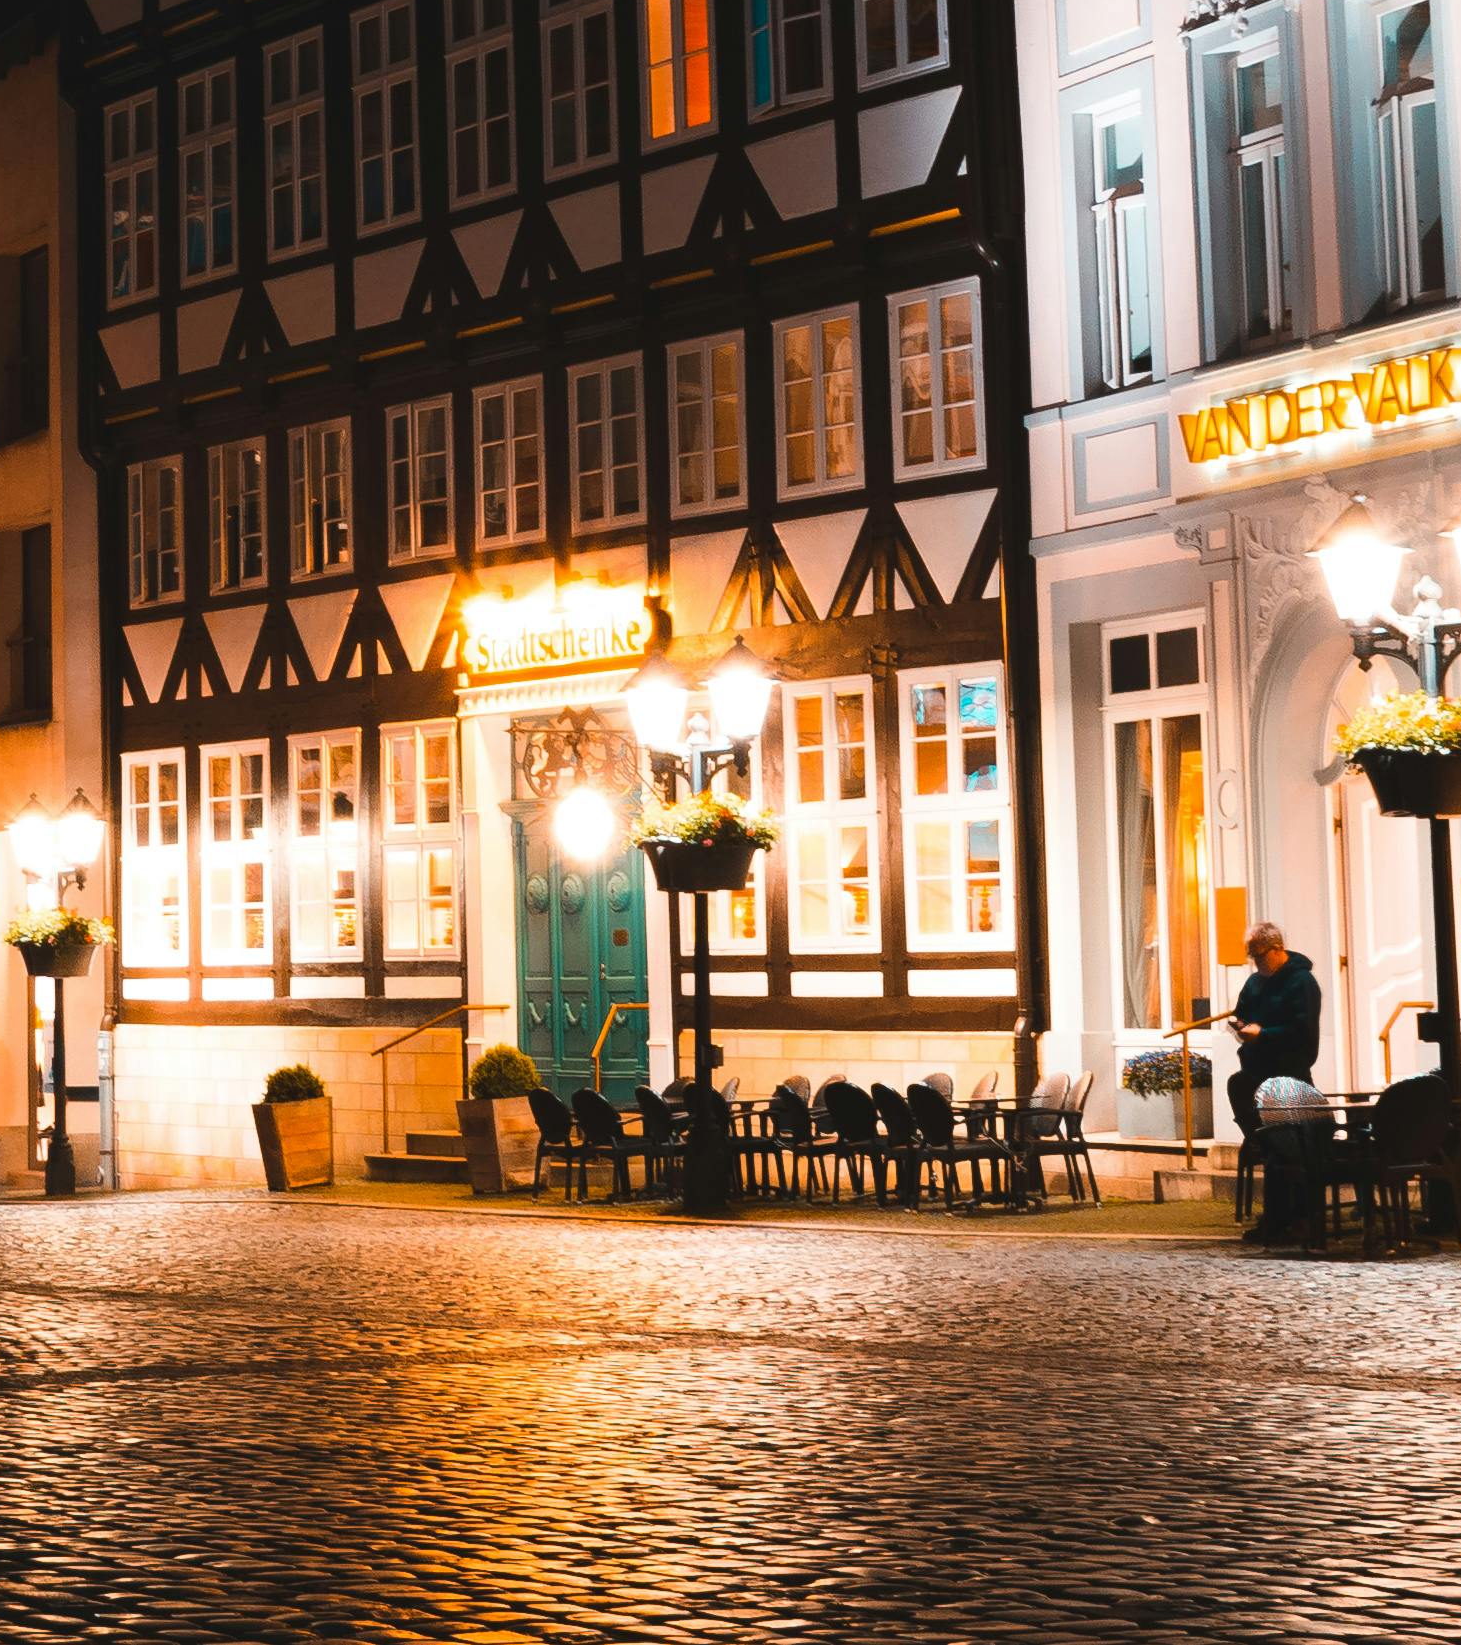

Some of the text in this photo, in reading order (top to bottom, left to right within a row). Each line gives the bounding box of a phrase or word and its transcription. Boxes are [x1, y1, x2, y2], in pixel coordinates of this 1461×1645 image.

[1177, 393, 1267, 463] VAN
[1265, 379, 1361, 445] DER
[476, 618, 641, 671] Stadtschenke
